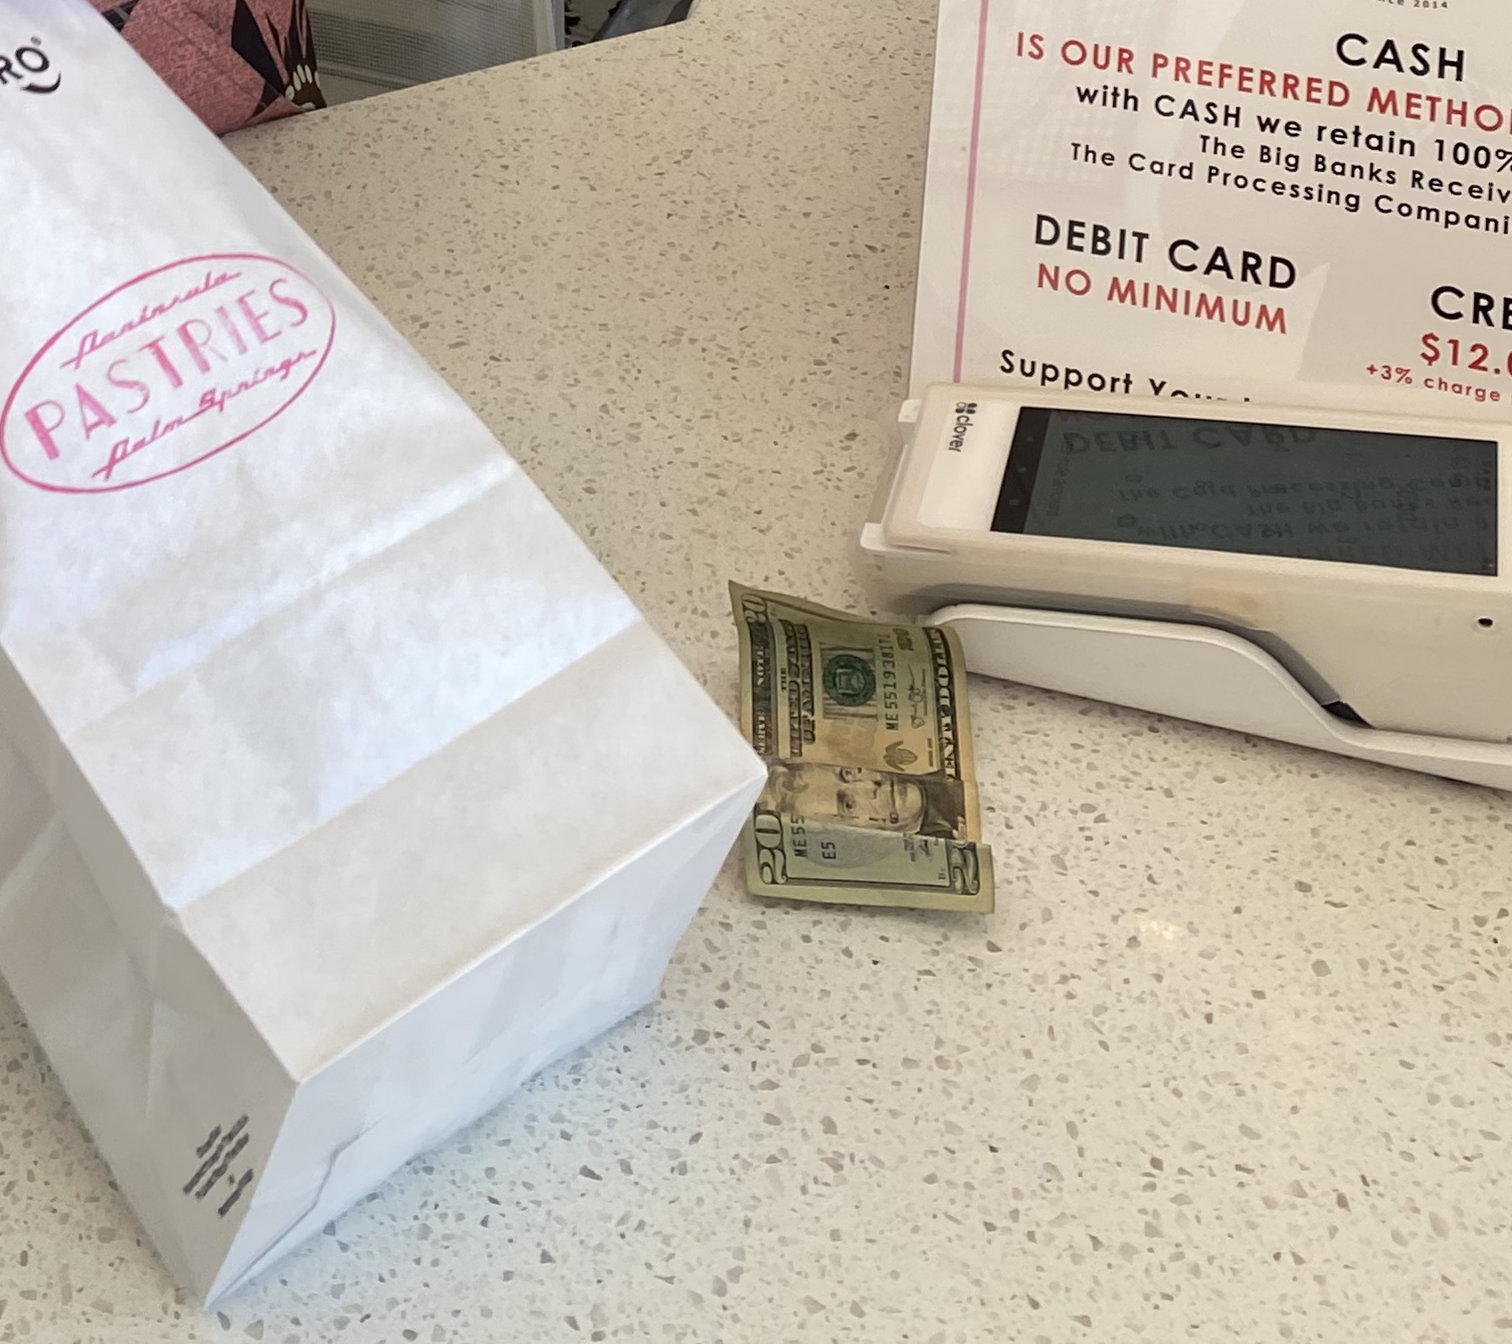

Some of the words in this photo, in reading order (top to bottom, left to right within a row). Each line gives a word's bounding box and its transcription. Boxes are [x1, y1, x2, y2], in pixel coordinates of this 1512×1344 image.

[1413, 0, 1448, 9] 2014
[1336, 33, 1464, 82] CASH
[1017, 31, 1044, 59] IS
[1061, 40, 1134, 75] OUR
[1151, 53, 1350, 107] PREFERRED
[1367, 87, 1512, 136] METHO
[1076, 85, 1138, 112] with
[1155, 95, 1241, 128] CASH
[1256, 115, 1302, 137] we
[1317, 125, 1416, 157] retain
[1071, 142, 1115, 166] The
[1129, 153, 1193, 180] Card
[1207, 166, 1360, 212] Processing
[1200, 135, 1245, 158] The
[1259, 145, 1299, 172] Big
[1315, 154, 1397, 185] Banks
[1035, 214, 1149, 263] DEBIT
[1168, 239, 1297, 289] CARD
[1037, 263, 1092, 296] NO
[1107, 277, 1286, 334] MINIMUM
[24, 278, 309, 460] PASTRIES
[1000, 349, 1133, 394] Support
[1366, 364, 1413, 384] +3%
[1424, 378, 1500, 402] charge
[949, 414, 974, 452] clover
[755, 646, 766, 687] NOTE
[754, 813, 788, 885] 20
[821, 841, 837, 860] E5
